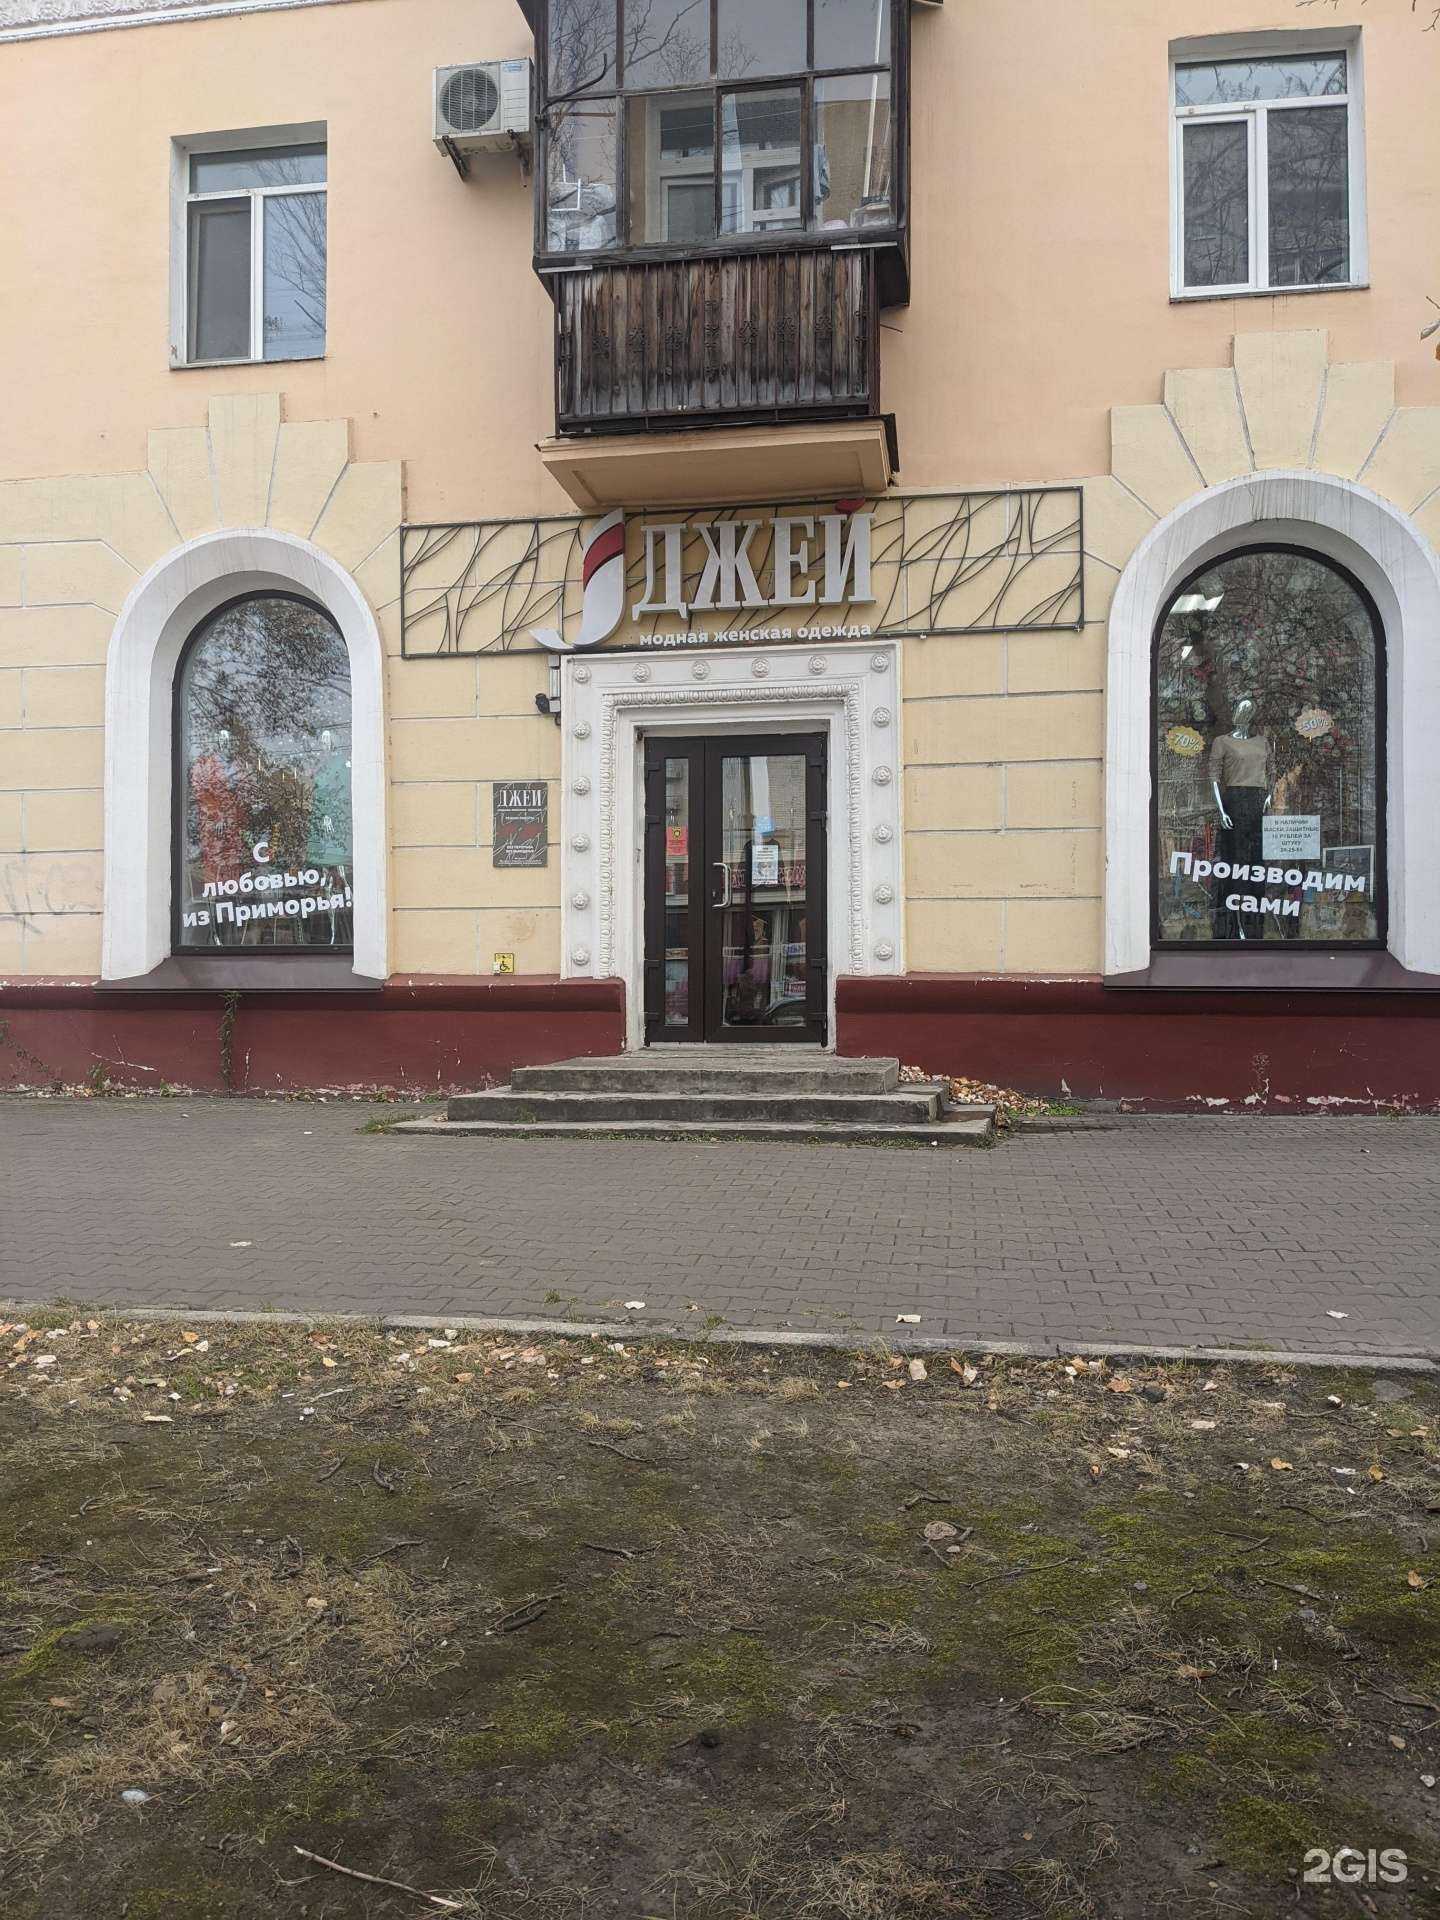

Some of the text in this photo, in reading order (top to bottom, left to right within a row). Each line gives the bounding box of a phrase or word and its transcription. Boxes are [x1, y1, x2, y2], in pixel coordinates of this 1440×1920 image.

[632, 498, 877, 621] ДЖЕЙ
[639, 623, 872, 647] модная женская одежда
[202, 869, 326, 898] любовью,
[1169, 851, 1366, 893] Производим
[182, 886, 352, 928] из Приморья!
[1225, 893, 1301, 917] сами
